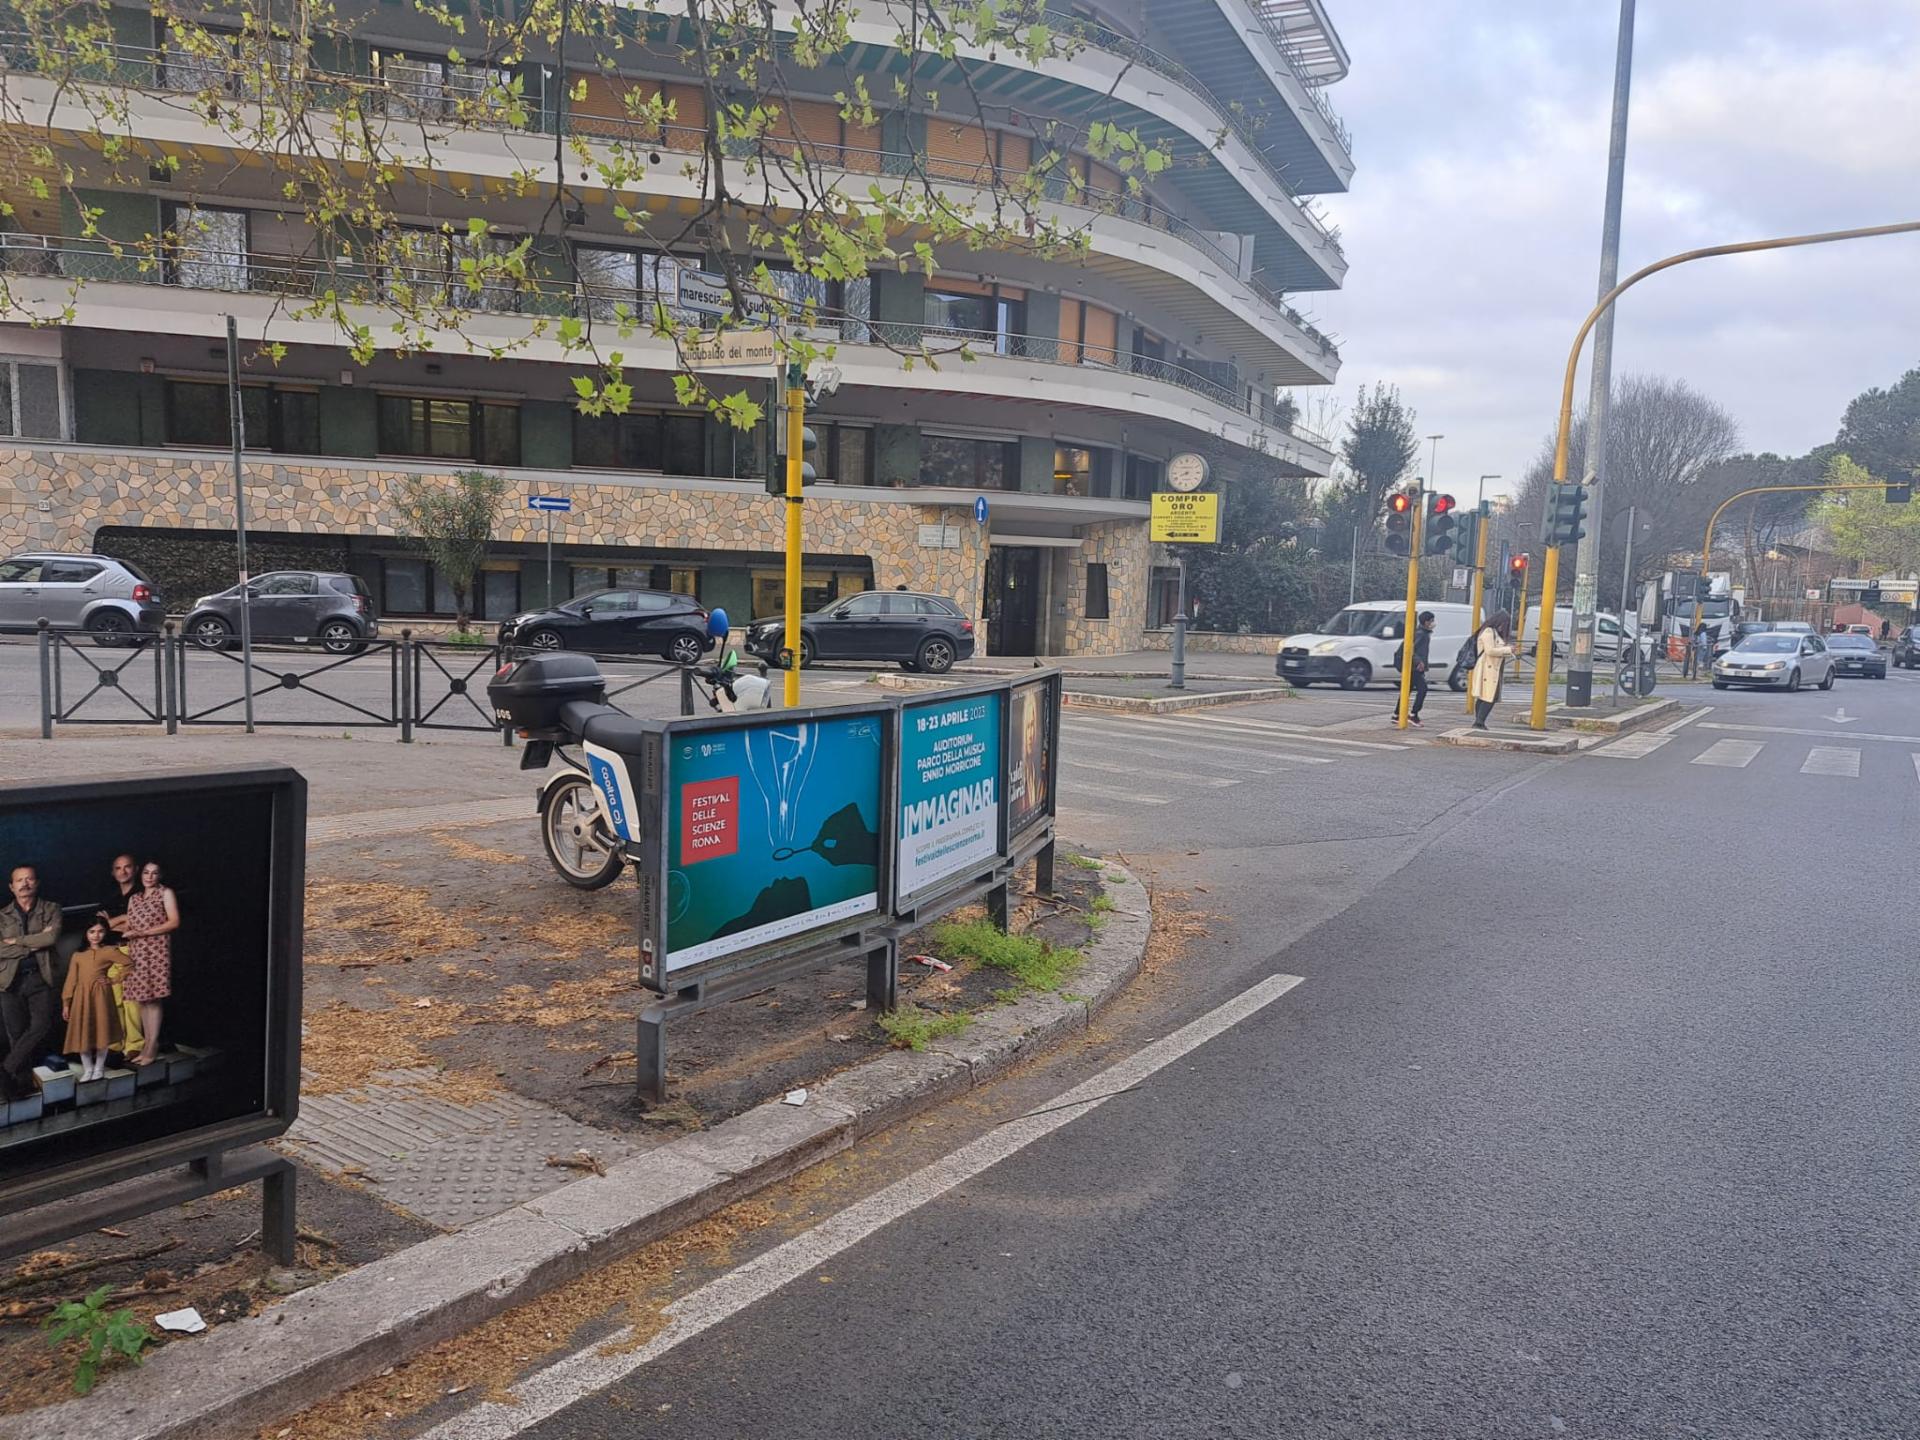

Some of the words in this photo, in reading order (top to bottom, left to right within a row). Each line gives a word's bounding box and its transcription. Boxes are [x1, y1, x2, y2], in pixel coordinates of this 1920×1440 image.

[680, 287, 734, 308] marescia
[729, 346, 742, 358] del
[746, 343, 773, 358] monte
[1160, 495, 1206, 503] COMPRO
[917, 715, 939, 732] 18-23
[940, 709, 969, 727] APRILE
[970, 705, 985, 721] 2023
[933, 733, 973, 753] AUDITORIUM
[917, 755, 941, 771] PARCO
[942, 749, 963, 764] DELLA
[963, 742, 986, 757] MUSICA
[922, 767, 944, 783] ENNIO
[945, 756, 982, 776] MORRICONE
[601, 766, 616, 805] cooltra
[692, 793, 730, 808] FESTIVAL
[692, 808, 716, 822] DELLE
[692, 820, 726, 835] SCIENZE
[692, 835, 721, 849] ROMA
